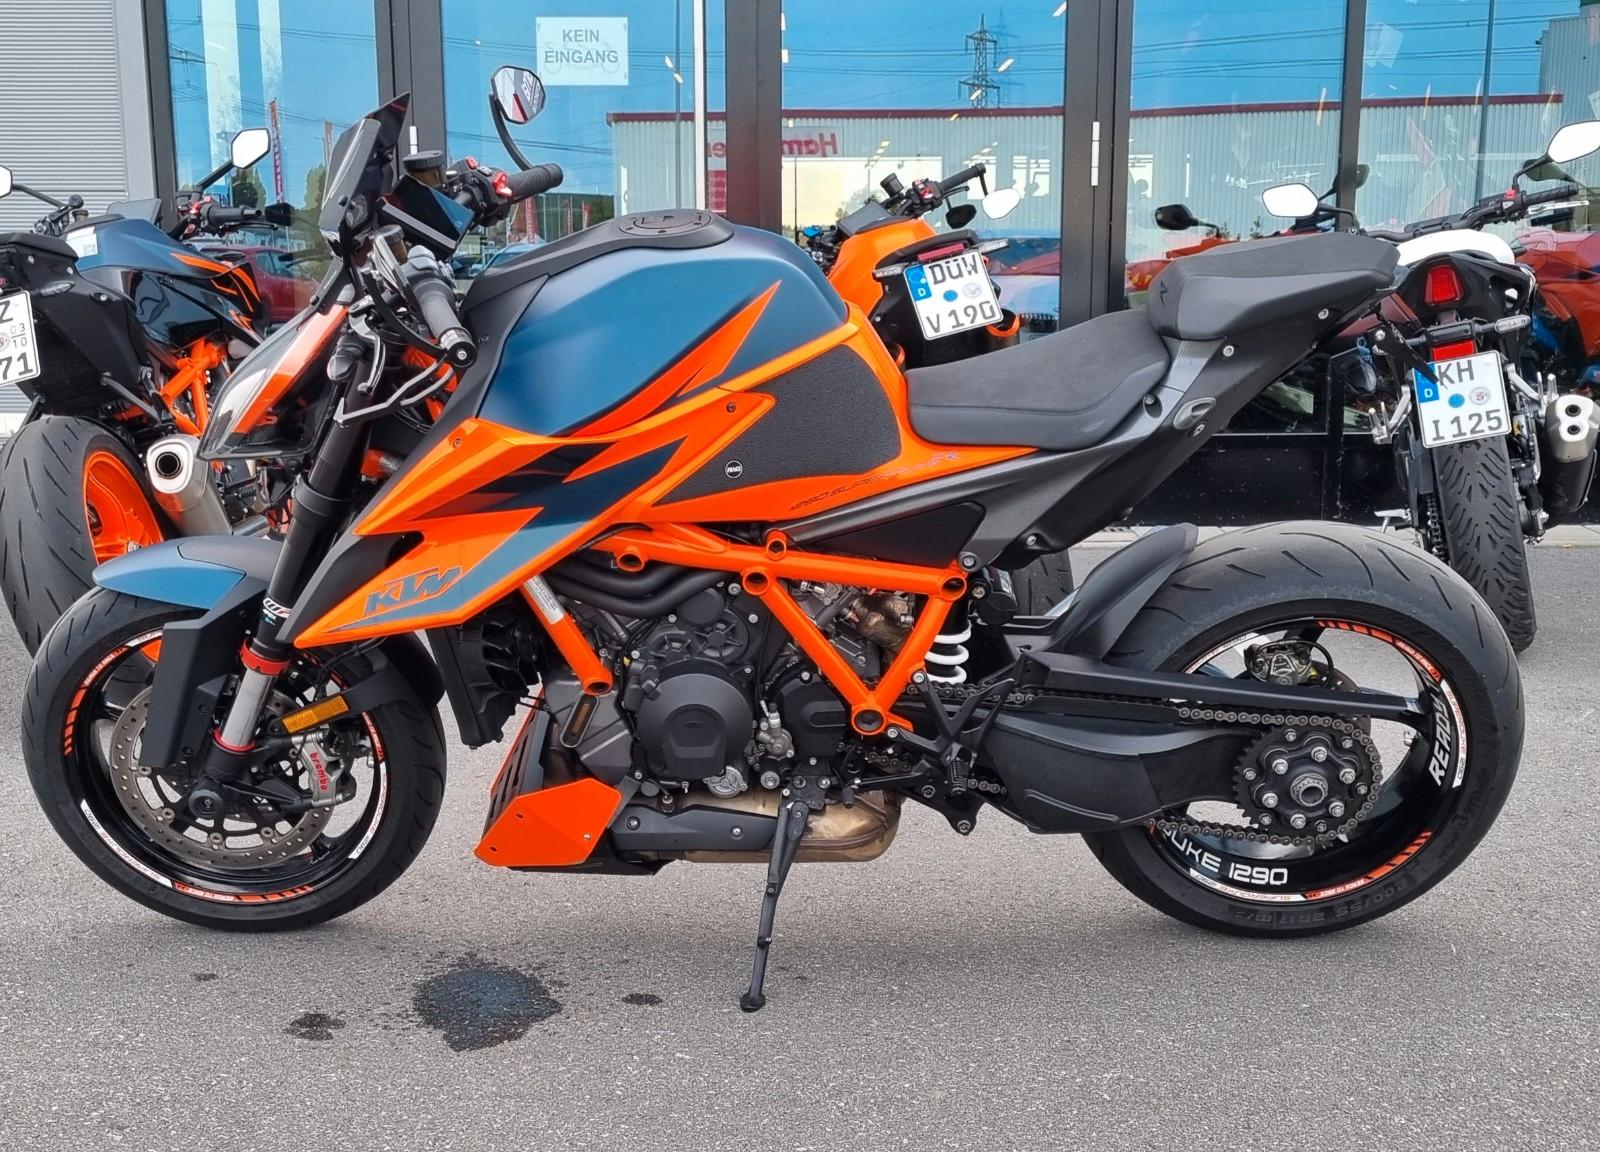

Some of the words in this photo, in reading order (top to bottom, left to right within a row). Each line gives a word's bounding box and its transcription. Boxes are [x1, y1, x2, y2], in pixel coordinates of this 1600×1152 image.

[562, 29, 600, 43] KEIN
[545, 50, 618, 64] EINGANG
[928, 254, 979, 285] DÜW
[1437, 359, 1475, 386] KH
[1449, 408, 1503, 439] 125
[363, 566, 462, 614] KTM
[1428, 695, 1451, 787] READY
[310, 752, 328, 790] brembo
[1228, 862, 1288, 886] 1290
